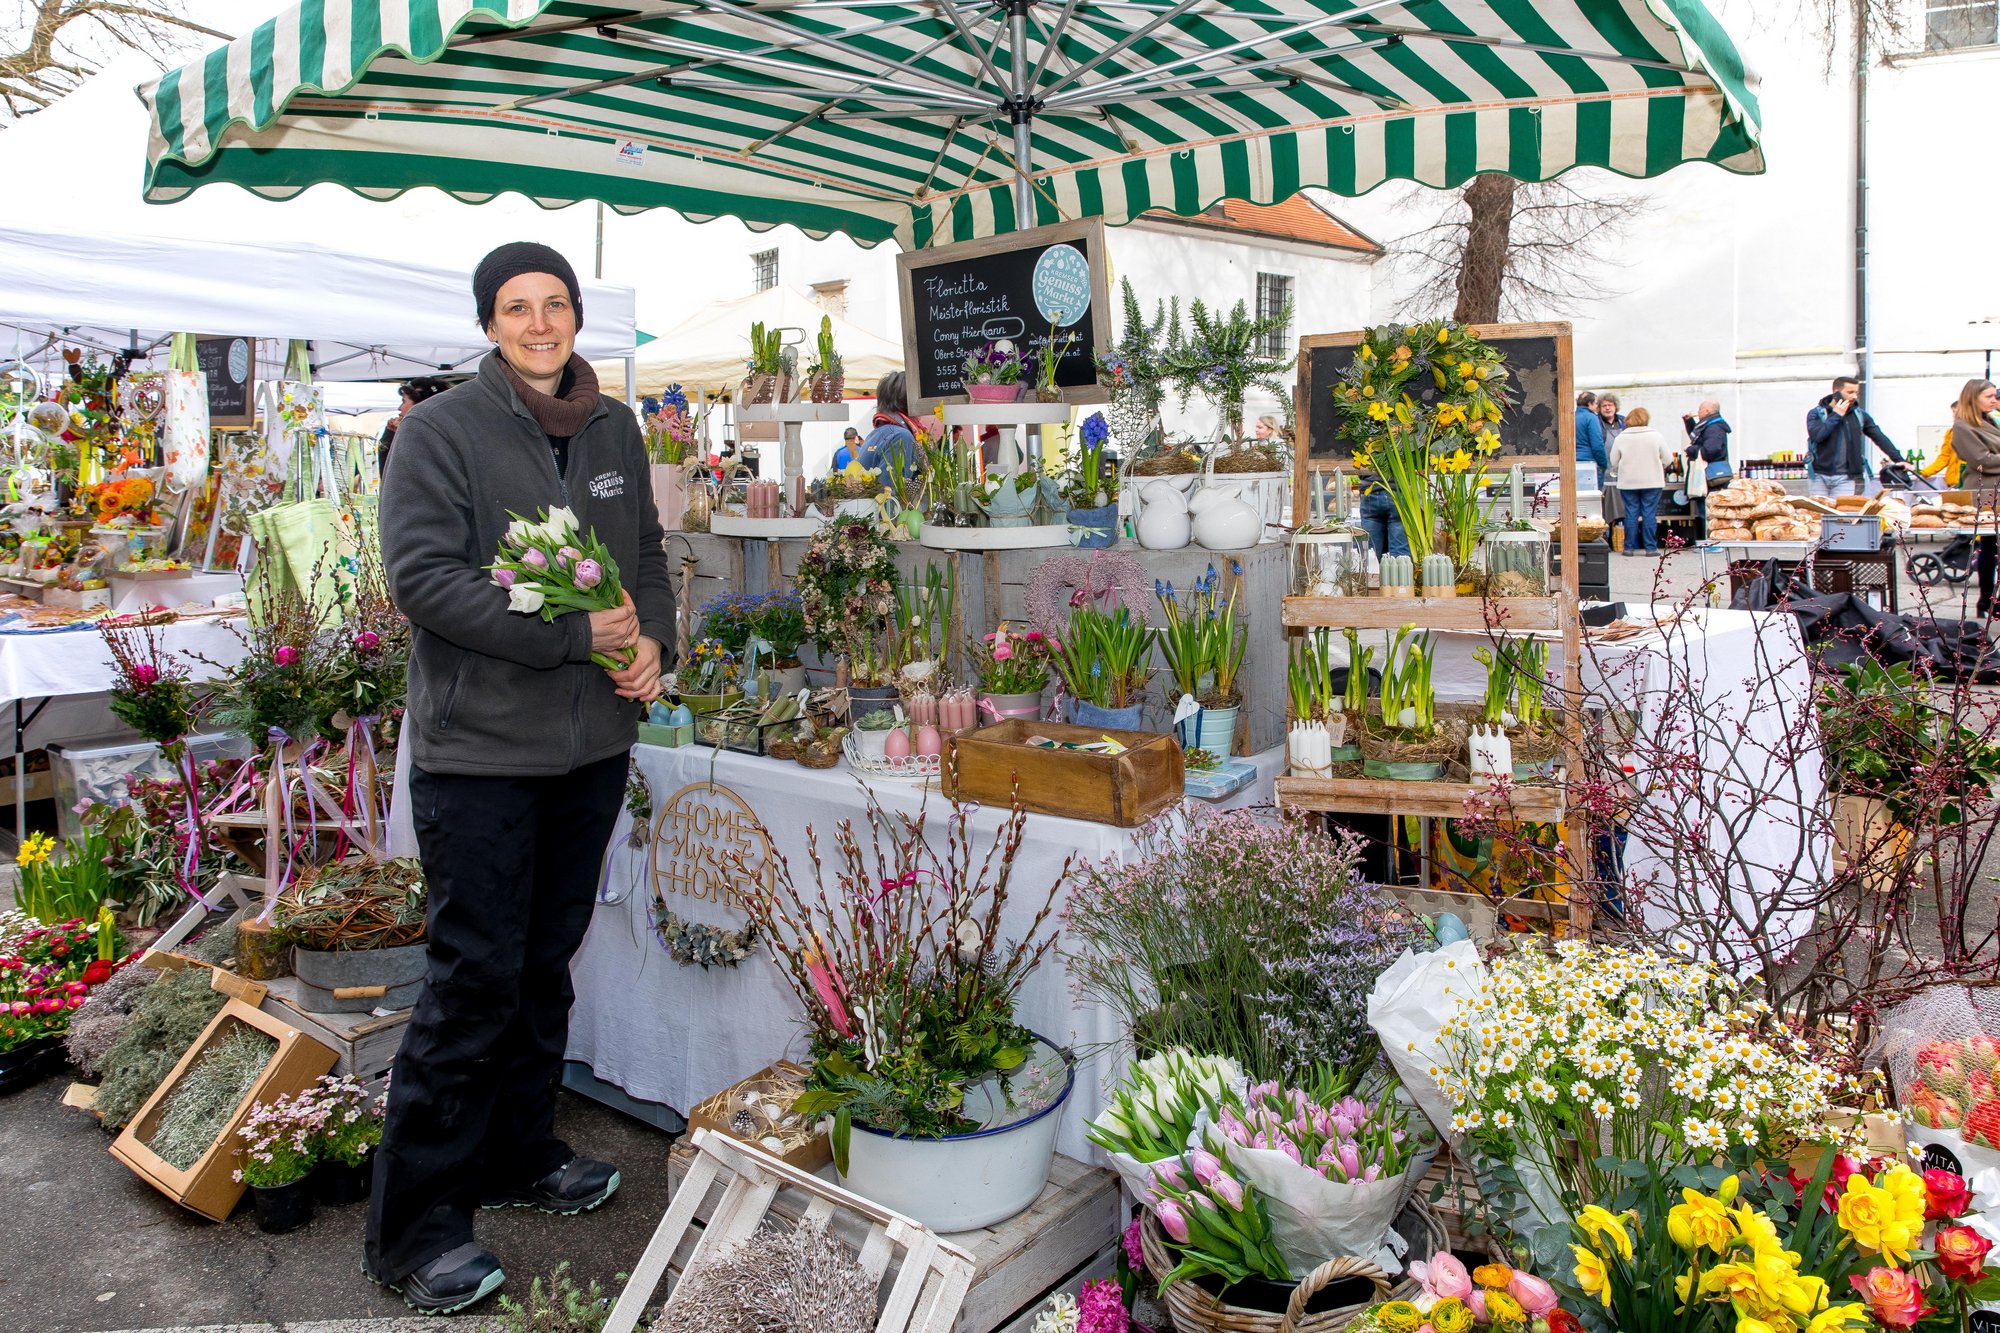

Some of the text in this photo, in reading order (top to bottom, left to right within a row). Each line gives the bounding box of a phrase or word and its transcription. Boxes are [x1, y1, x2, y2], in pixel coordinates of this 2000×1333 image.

[924, 273, 988, 298] Florietta
[1039, 270, 1082, 295] Genuss
[1051, 269, 1078, 283] KREMSER
[1043, 285, 1074, 305] Markt
[929, 295, 1011, 321] Meisterfloristik
[933, 328, 960, 345] Conny
[936, 364, 958, 376] 3553
[589, 475, 624, 497] Genuss
[667, 799, 753, 844] HOME
[664, 860, 752, 911] HOME
[1925, 1149, 1957, 1173] VITA
